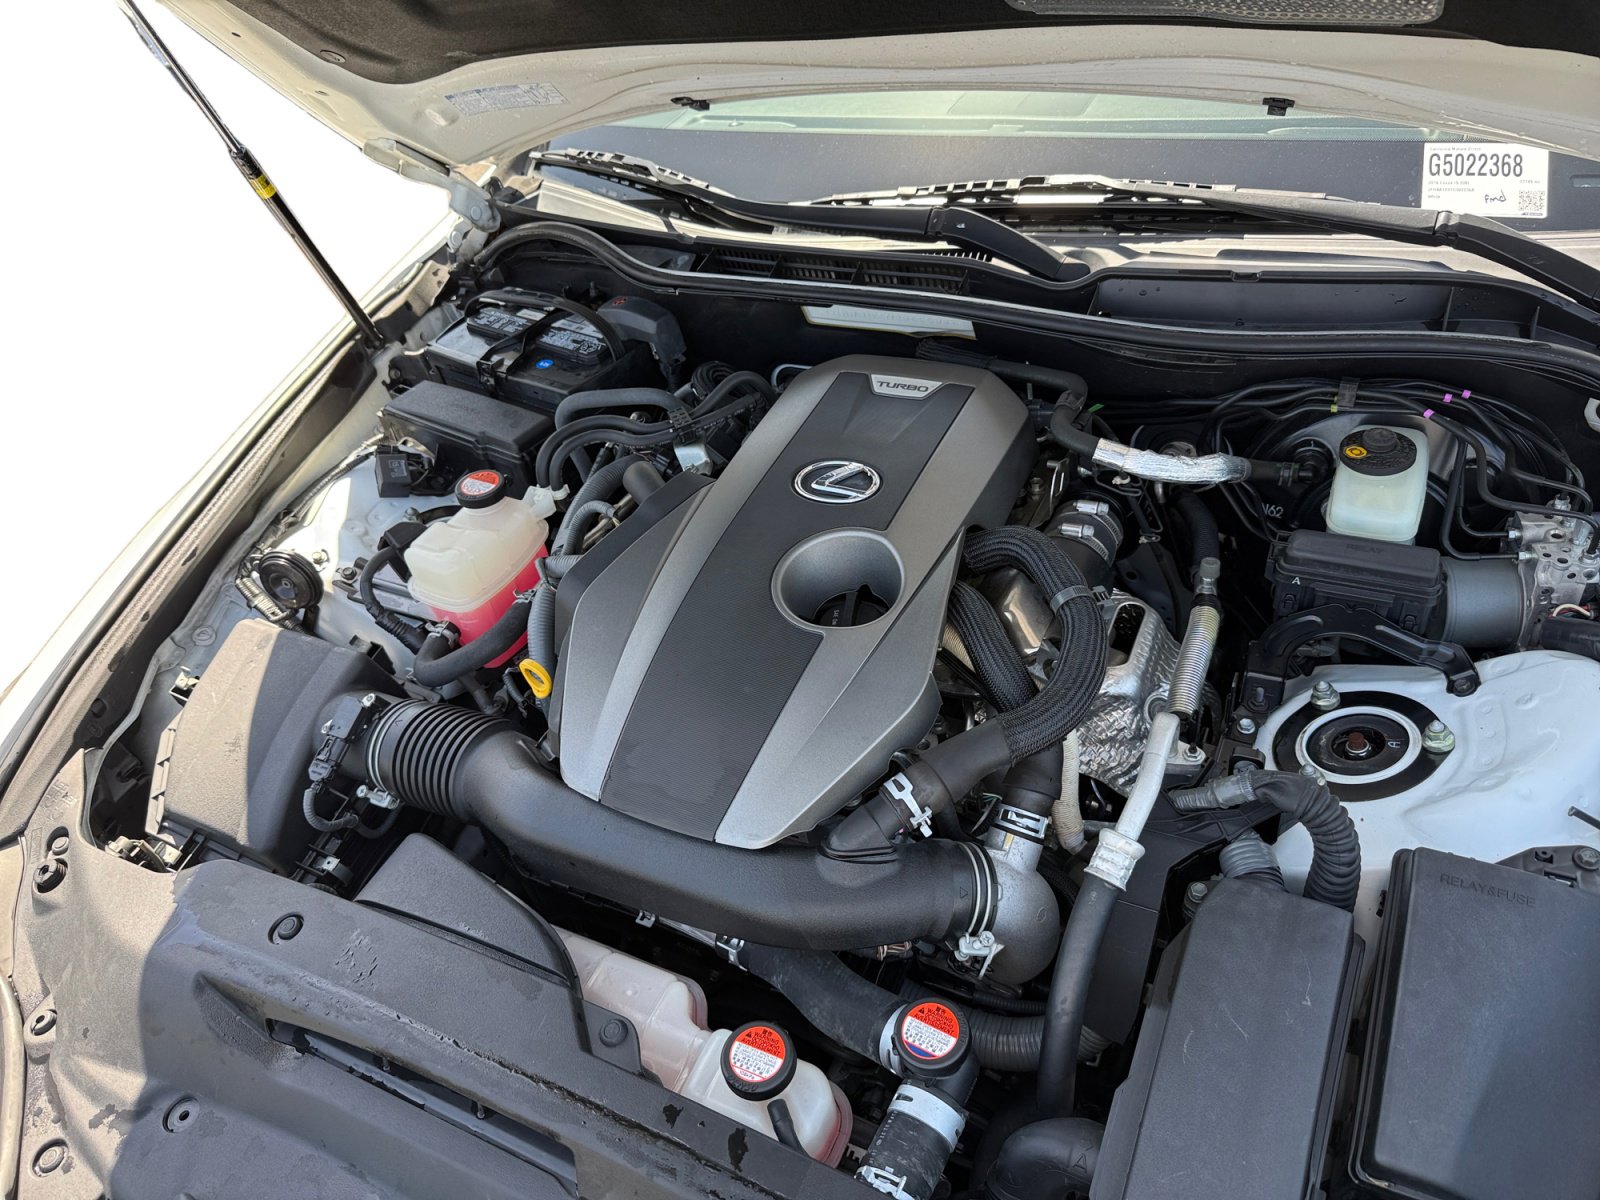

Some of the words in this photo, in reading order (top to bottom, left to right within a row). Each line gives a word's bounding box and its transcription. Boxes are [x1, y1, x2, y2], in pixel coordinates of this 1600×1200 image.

[1428, 153, 1523, 177] G5022368
[877, 380, 929, 392] TURBO
[1291, 576, 1301, 585] A
[1439, 873, 1537, 906] RELAY&FUSE
[928, 1008, 953, 1024] WARNING
[754, 1031, 780, 1046] WARNING
